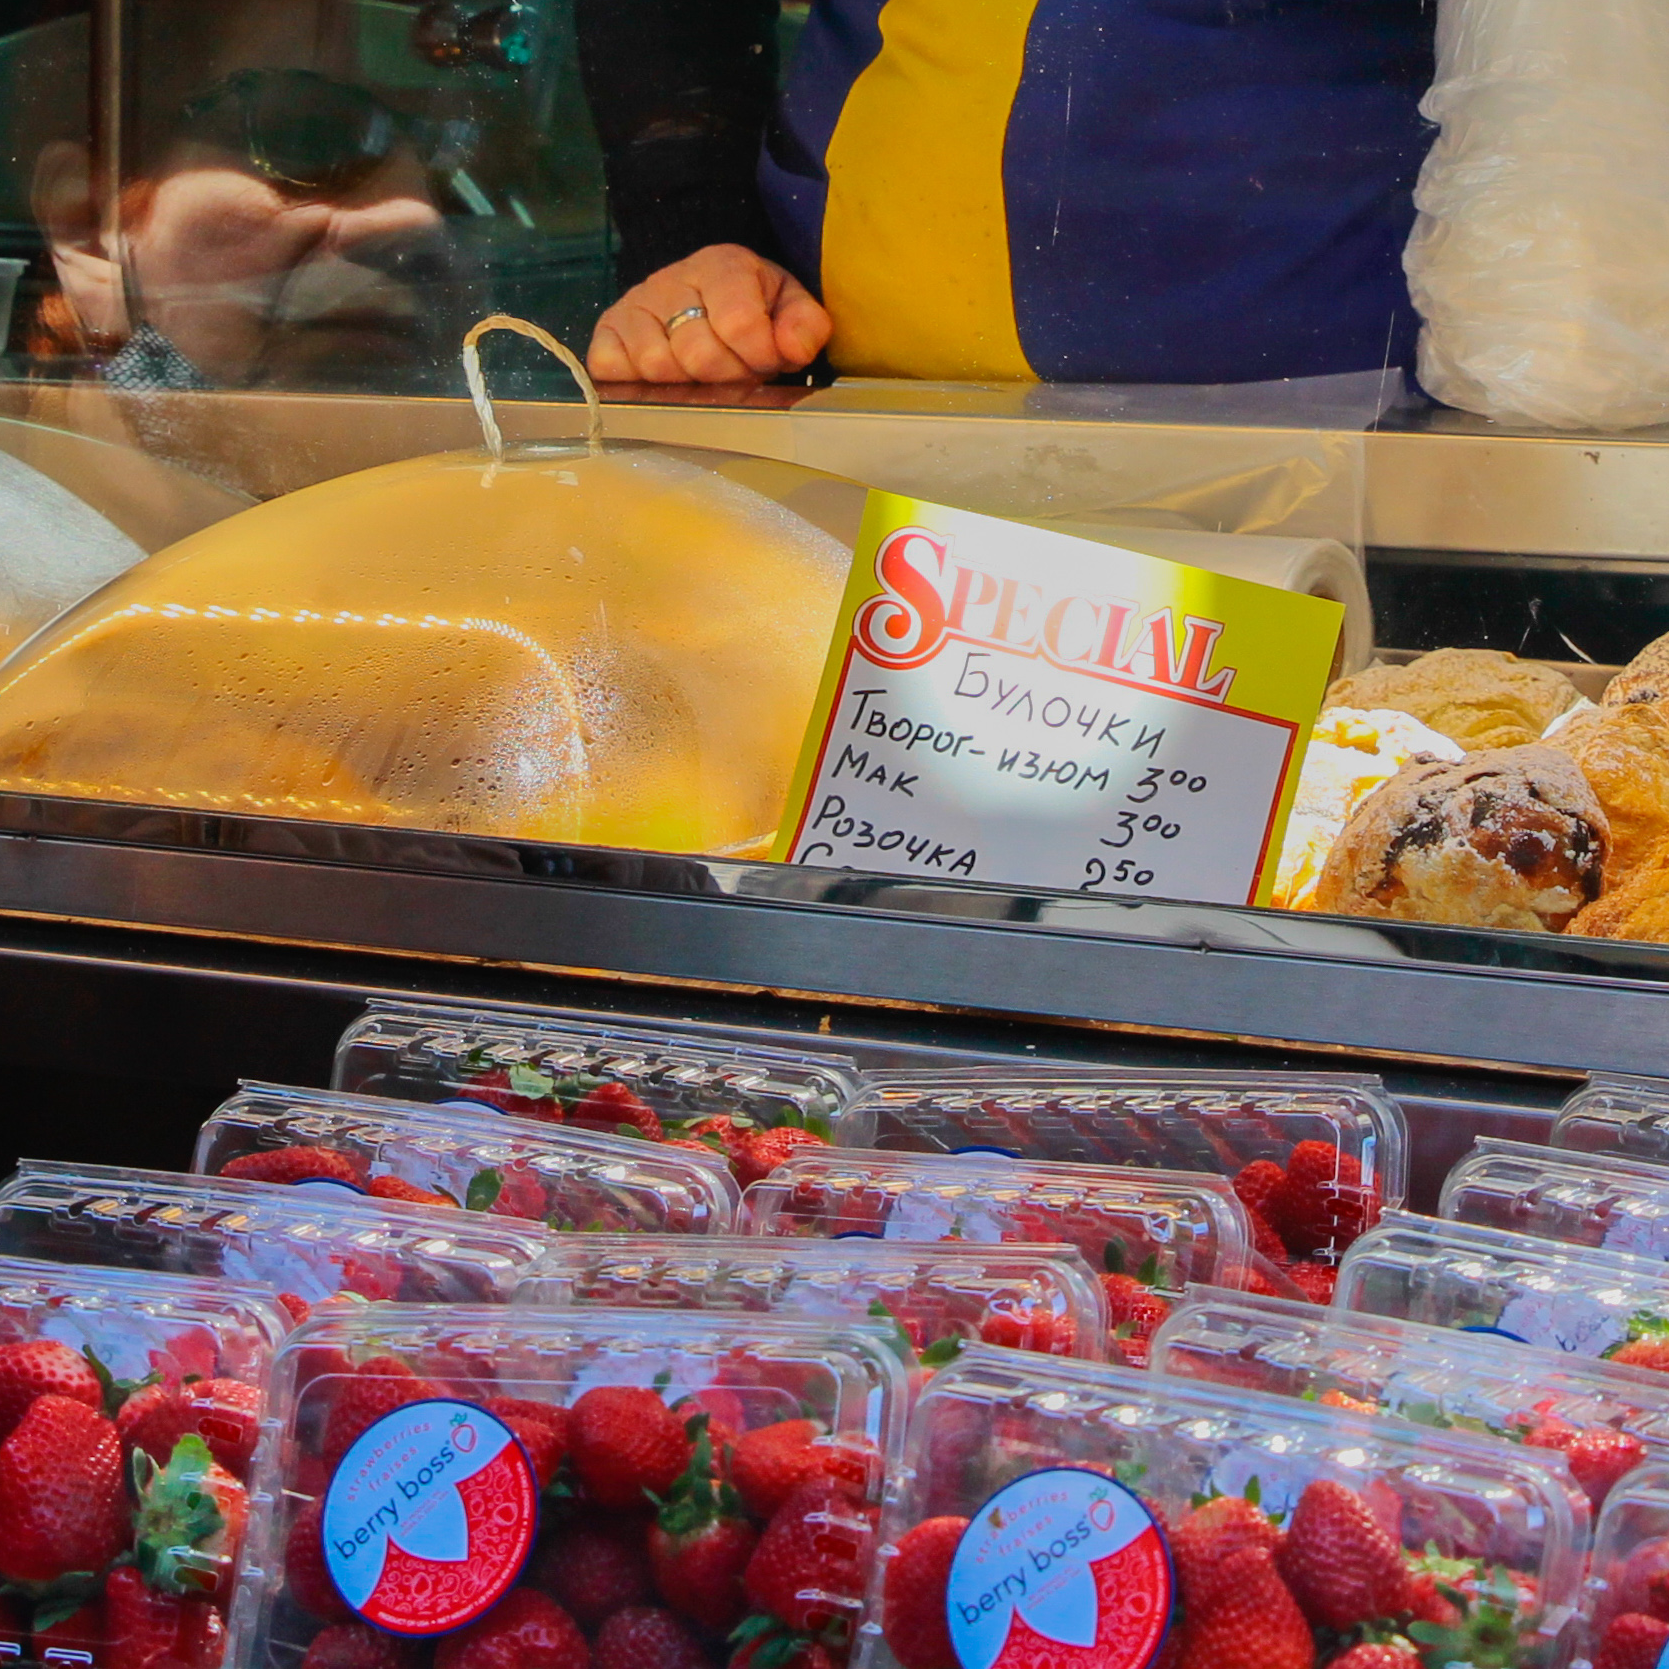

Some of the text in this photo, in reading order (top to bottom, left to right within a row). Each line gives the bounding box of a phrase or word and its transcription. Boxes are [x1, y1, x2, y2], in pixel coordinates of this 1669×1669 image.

[853, 526, 1238, 704] SPECIAL
[333, 1497, 400, 1559] berry
[396, 1444, 456, 1501] boss
[957, 1566, 1027, 1626] berry
[1027, 1519, 1091, 1573] boss
